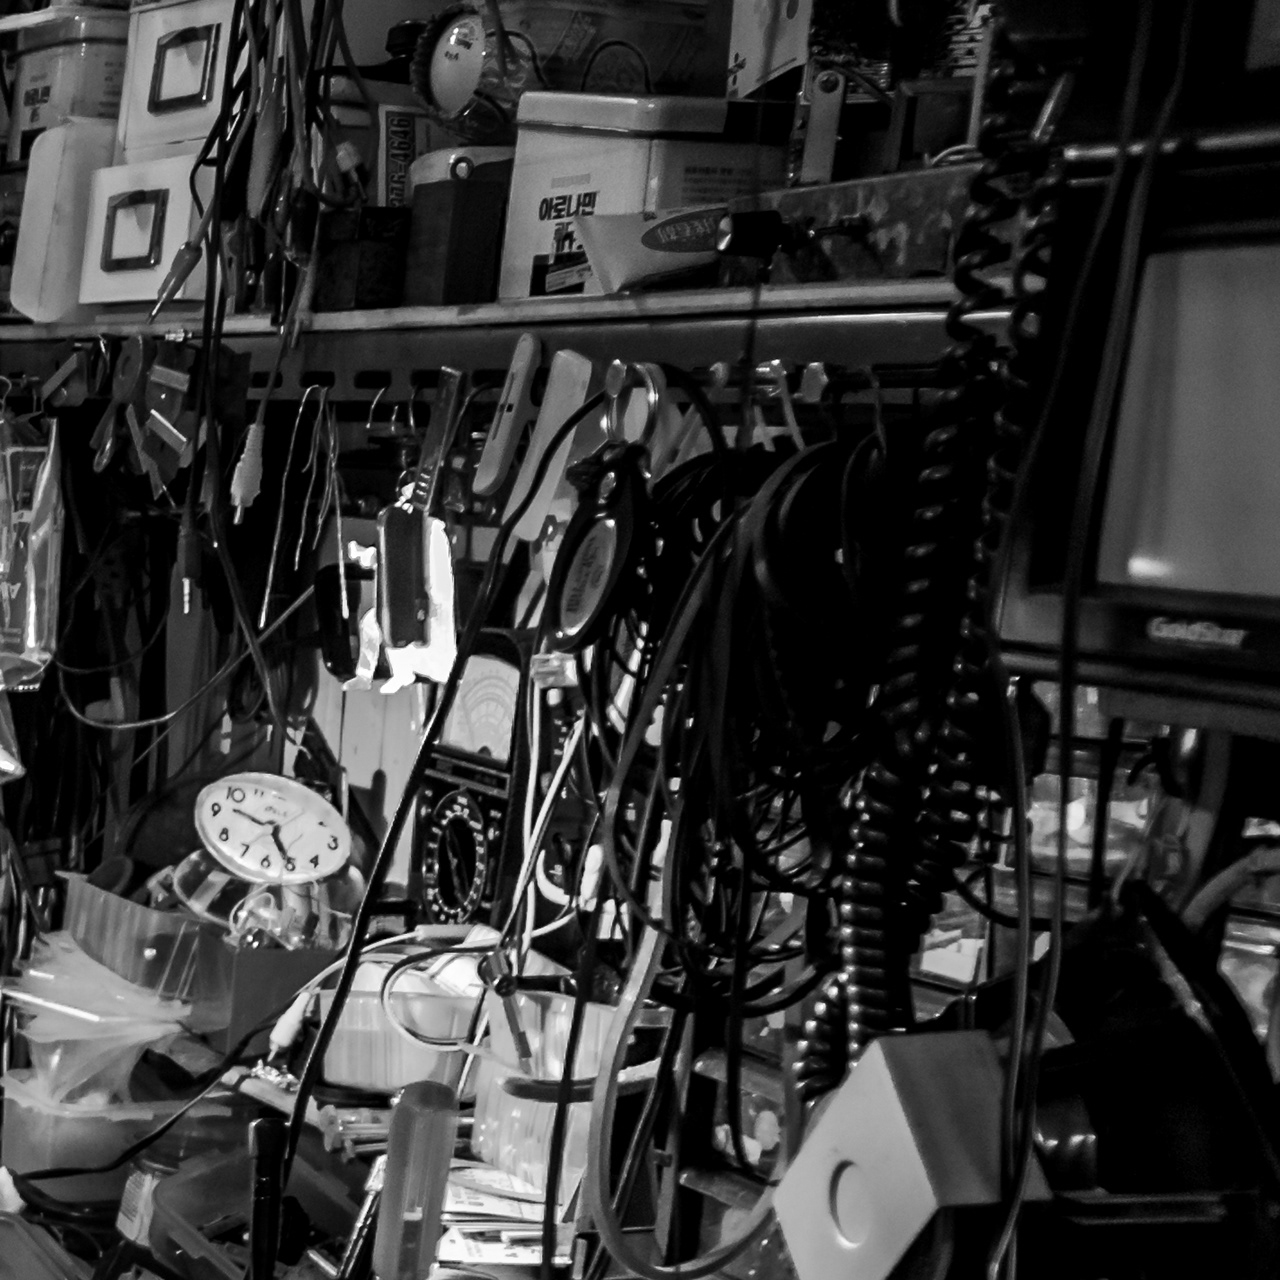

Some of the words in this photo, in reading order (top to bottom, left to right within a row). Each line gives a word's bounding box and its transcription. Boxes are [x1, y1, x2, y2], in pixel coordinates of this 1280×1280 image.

[539, 190, 598, 221] 아로나민
[227, 786, 246, 803] 10
[211, 803, 222, 817] 9
[219, 827, 230, 842] 8
[241, 843, 250, 857] 7
[327, 835, 339, 851] 3
[260, 855, 272, 869] 6
[309, 854, 320, 869] 4
